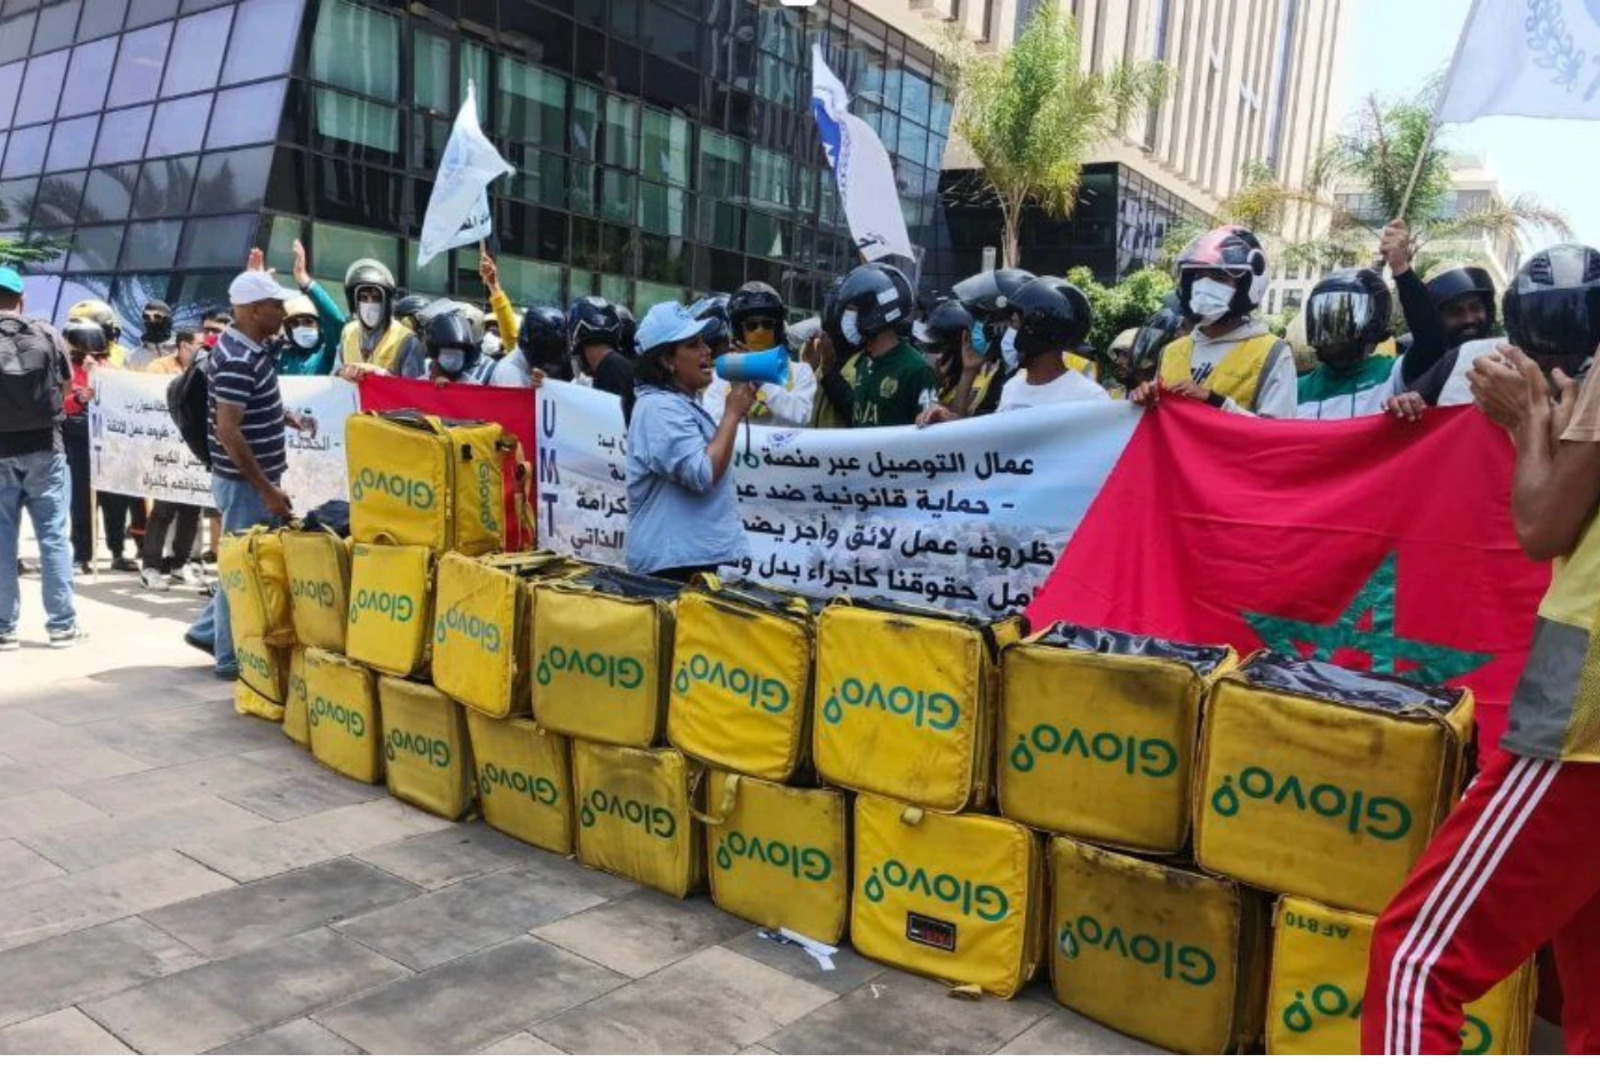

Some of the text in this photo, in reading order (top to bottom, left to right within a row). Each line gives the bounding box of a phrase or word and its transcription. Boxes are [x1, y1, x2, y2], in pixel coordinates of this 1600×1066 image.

[763, 446, 820, 469] منصة
[828, 454, 861, 478] عبر
[868, 451, 965, 479] التوصيل
[975, 450, 1034, 480] عمال
[360, 467, 434, 510] Glovo
[766, 484, 806, 502] ضد
[812, 482, 907, 511] قانونية
[916, 489, 990, 518] حماية
[571, 528, 625, 555] الذاتي
[791, 514, 839, 547] وأجر
[845, 525, 897, 551] لائق
[901, 530, 957, 558] عمل
[758, 553, 800, 584] بدل
[968, 537, 1055, 569] ظروف
[807, 559, 878, 590] كأجراء
[887, 569, 978, 602] حقوقنا
[358, 588, 413, 622] Glovo
[445, 607, 501, 652] Glovo
[549, 645, 645, 690] Glovo
[690, 654, 790, 713] Glovo
[314, 697, 365, 738] Glovo
[840, 677, 961, 732] Glovo
[391, 727, 451, 768] Glovo
[1032, 723, 1178, 779] Glovo
[485, 762, 558, 806] Glovo
[591, 789, 677, 839] Glovo
[1240, 766, 1411, 841] Glovo
[728, 830, 833, 882] Glovo
[884, 859, 1009, 922] Glovo
[1080, 915, 1216, 986] Glovo
